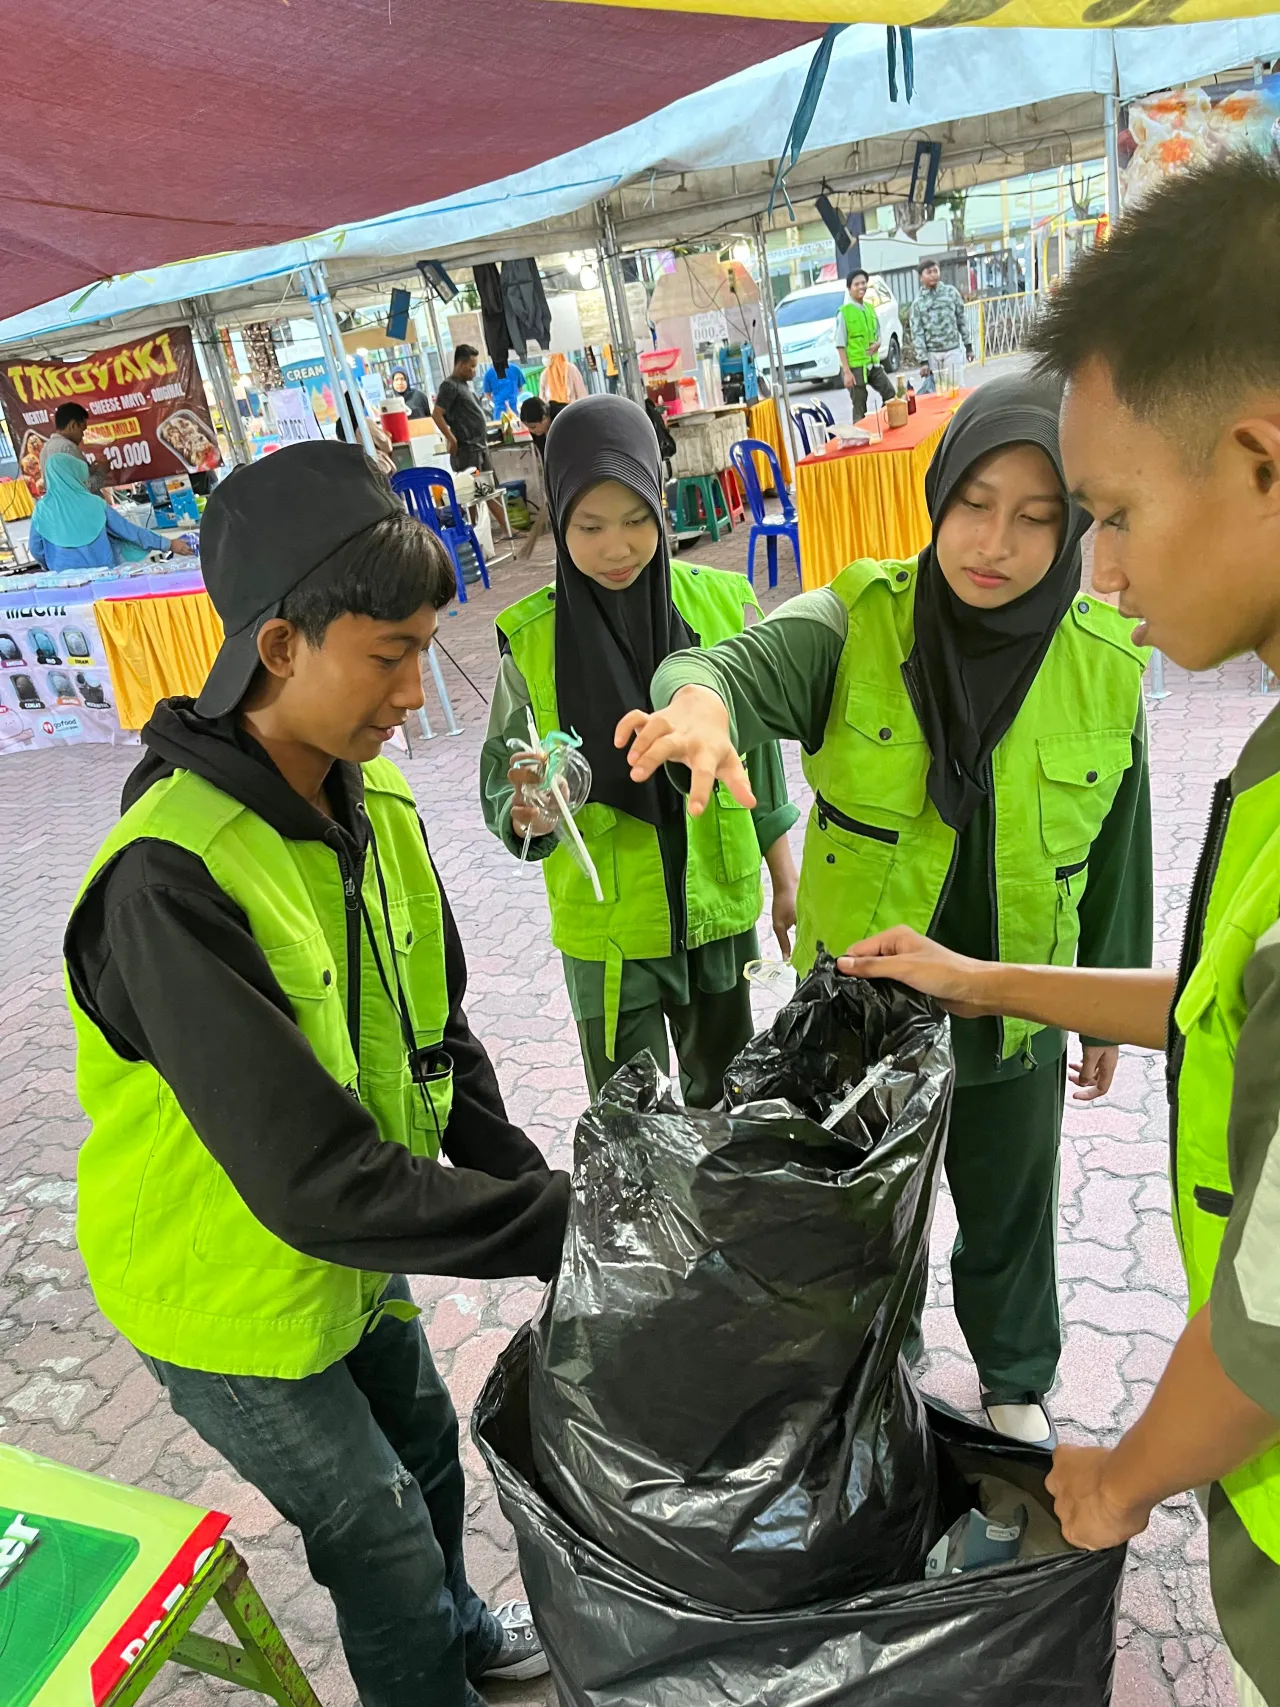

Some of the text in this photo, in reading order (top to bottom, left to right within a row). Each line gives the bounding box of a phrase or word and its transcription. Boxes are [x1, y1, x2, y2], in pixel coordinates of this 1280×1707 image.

[8, 333, 178, 404] TAKOYAKI
[286, 364, 326, 381] CREAM
[89, 401, 122, 416] CHEESE
[120, 391, 147, 409] MAYO
[151, 383, 186, 403] ORIGINAL
